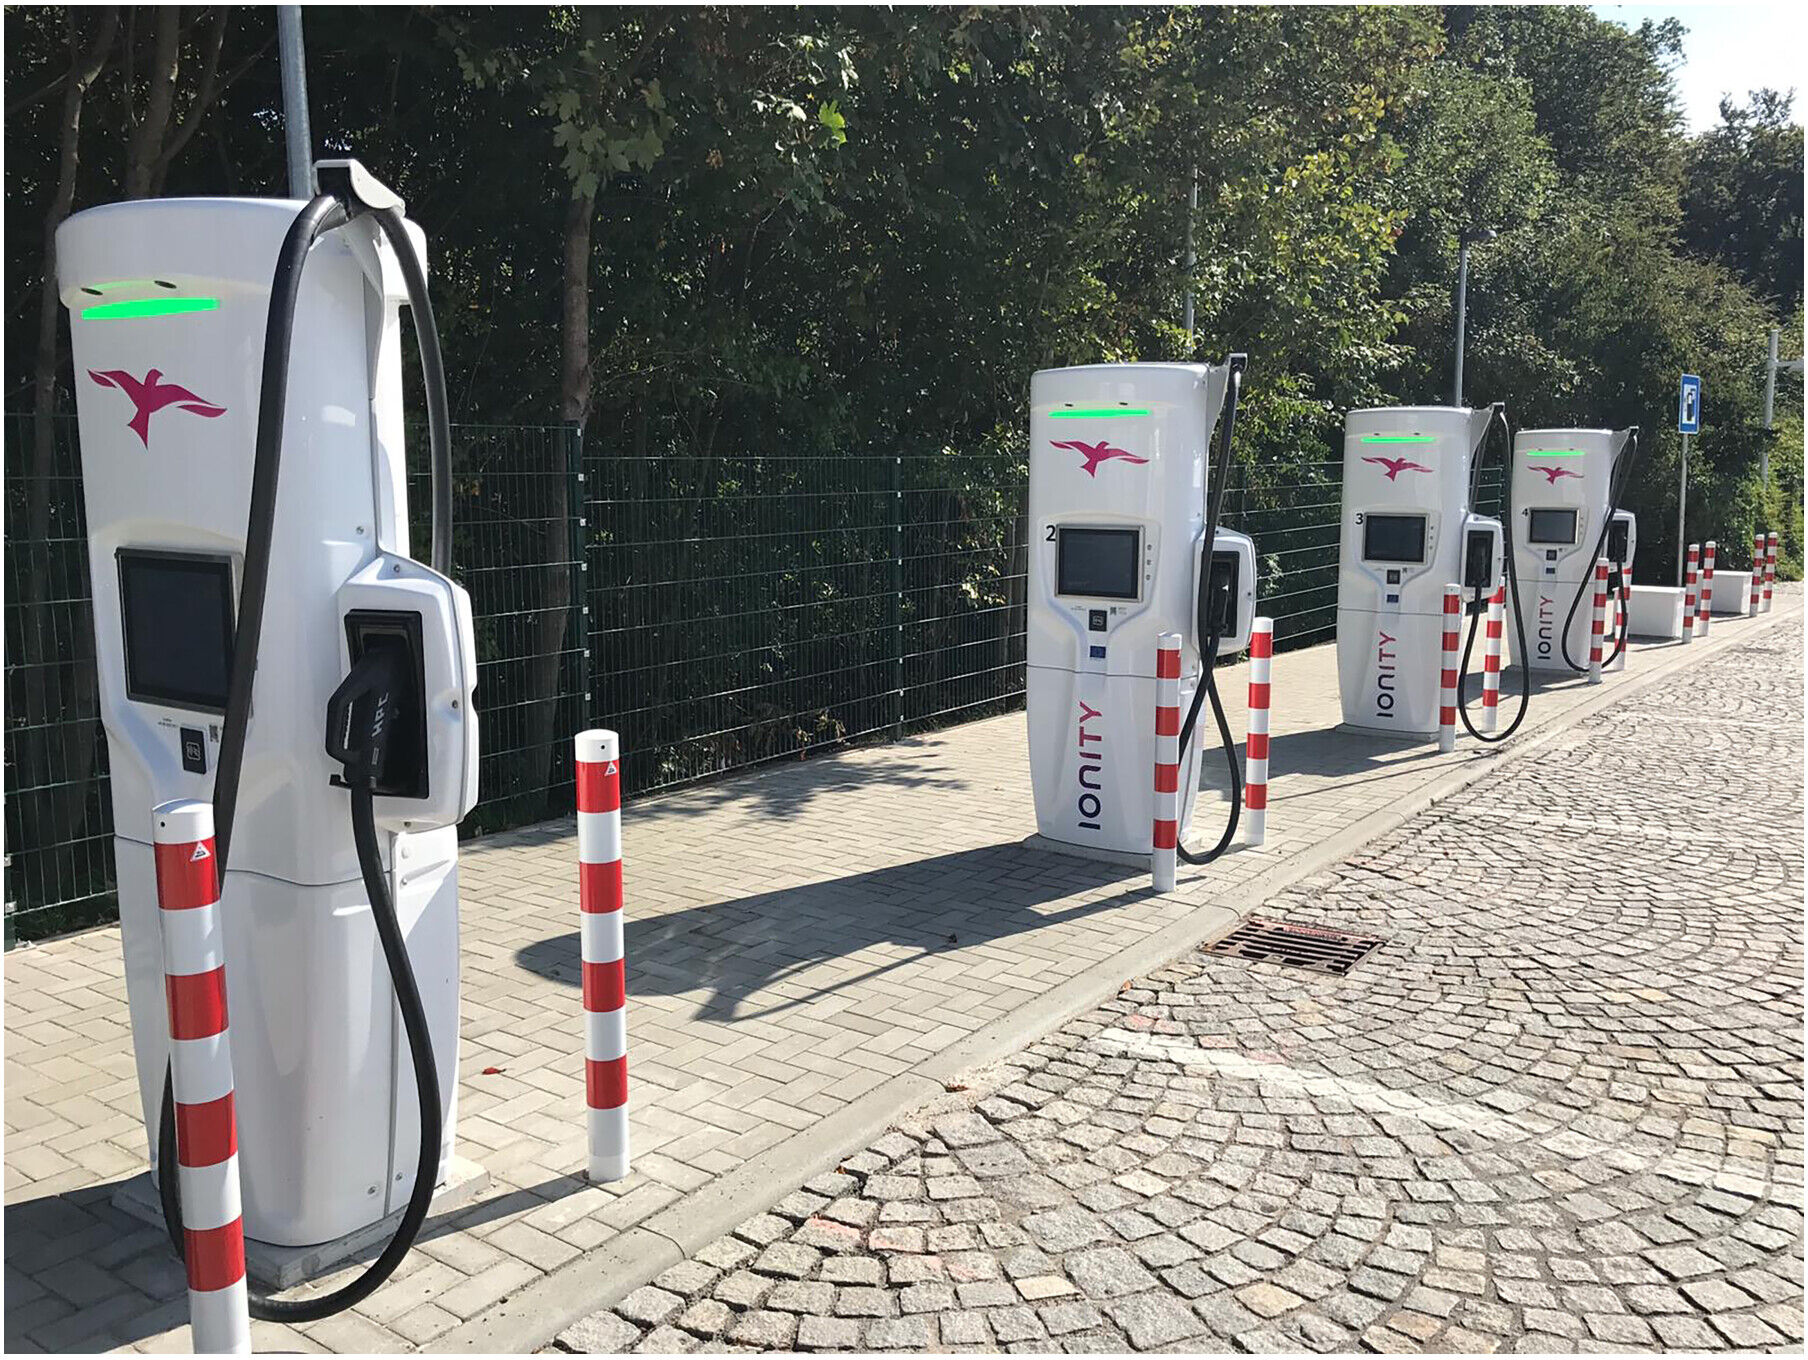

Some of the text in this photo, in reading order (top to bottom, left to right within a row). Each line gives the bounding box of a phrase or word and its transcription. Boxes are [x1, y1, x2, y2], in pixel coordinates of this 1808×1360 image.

[1355, 513, 1364, 525] 3
[1521, 508, 1529, 518] 4
[1045, 524, 1056, 542] 2
[1376, 631, 1397, 718] IONITY
[1078, 701, 1102, 830] IONITY
